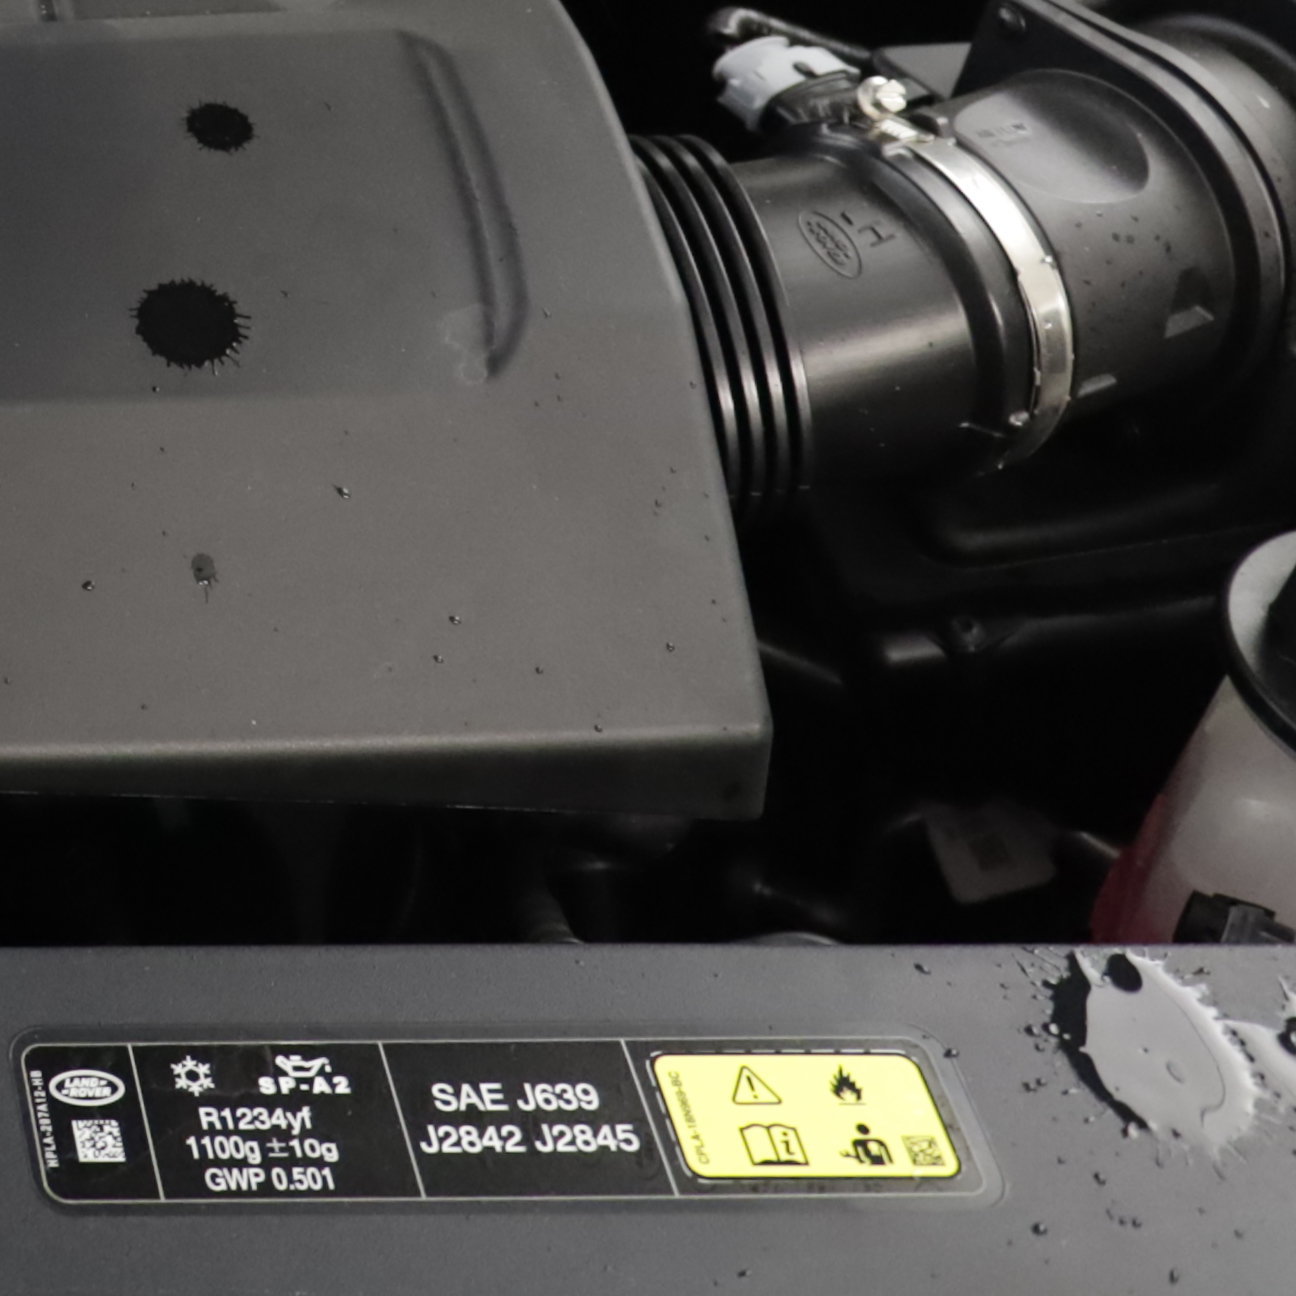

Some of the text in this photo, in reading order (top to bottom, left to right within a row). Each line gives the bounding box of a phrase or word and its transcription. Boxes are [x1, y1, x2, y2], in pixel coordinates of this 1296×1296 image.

[64, 1078, 100, 1088] LAND
[70, 1087, 112, 1098] ROVER
[258, 1076, 352, 1094] SP-A2
[431, 1083, 600, 1112] SAE J639
[198, 1106, 312, 1135] R1234yf
[185, 1135, 262, 1165] 1100g
[420, 1124, 640, 1153] J2842 J2845
[204, 1167, 336, 1191] GWP 0.501
